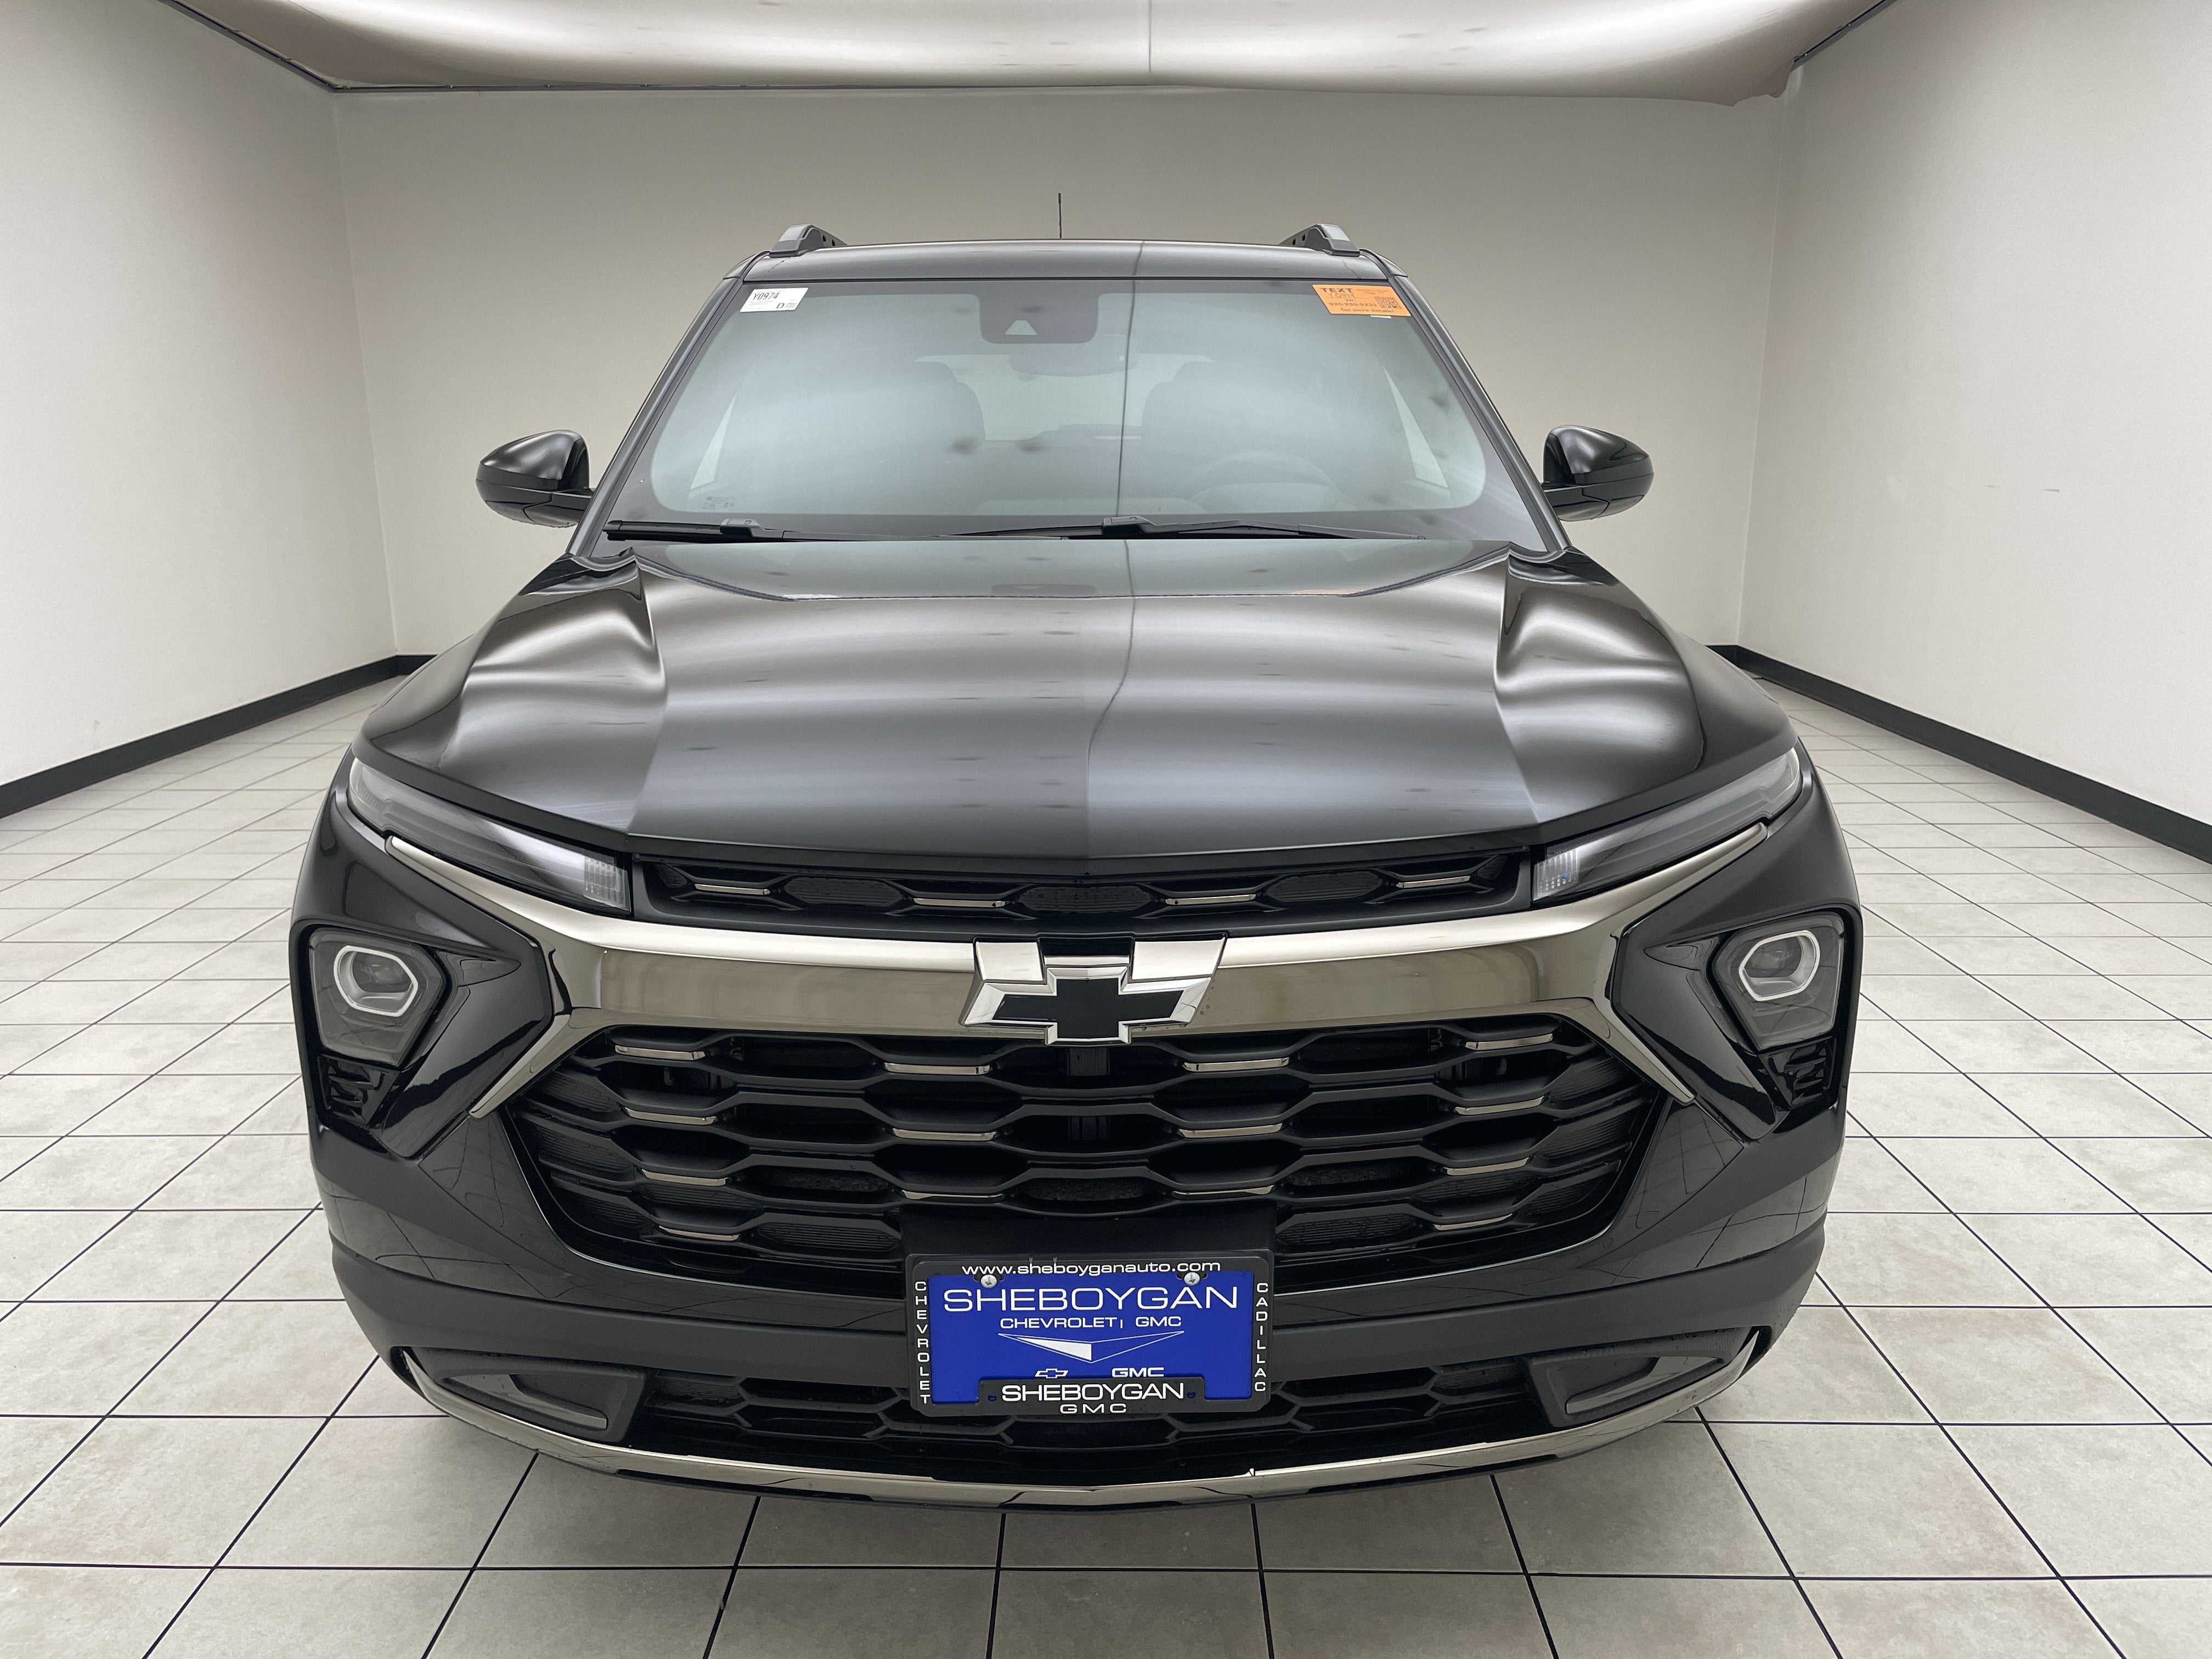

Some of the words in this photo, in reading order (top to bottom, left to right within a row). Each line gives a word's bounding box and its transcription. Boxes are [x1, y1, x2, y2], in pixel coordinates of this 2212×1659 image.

[752, 292, 780, 301] Y0974
[961, 1261, 1221, 1276] www.sheboyganauto.com
[943, 1285, 1238, 1313] SHEBOYGAN
[1000, 1317, 1118, 1329] CHEVROLET
[1135, 1316, 1182, 1328] GMC
[914, 1281, 930, 1405] CHEVROLET
[1254, 1283, 1268, 1392] CADILLAC
[1111, 1367, 1165, 1378] GMC
[1001, 1382, 1184, 1402] SHEBOYGAN
[1059, 1403, 1127, 1414] GMC
